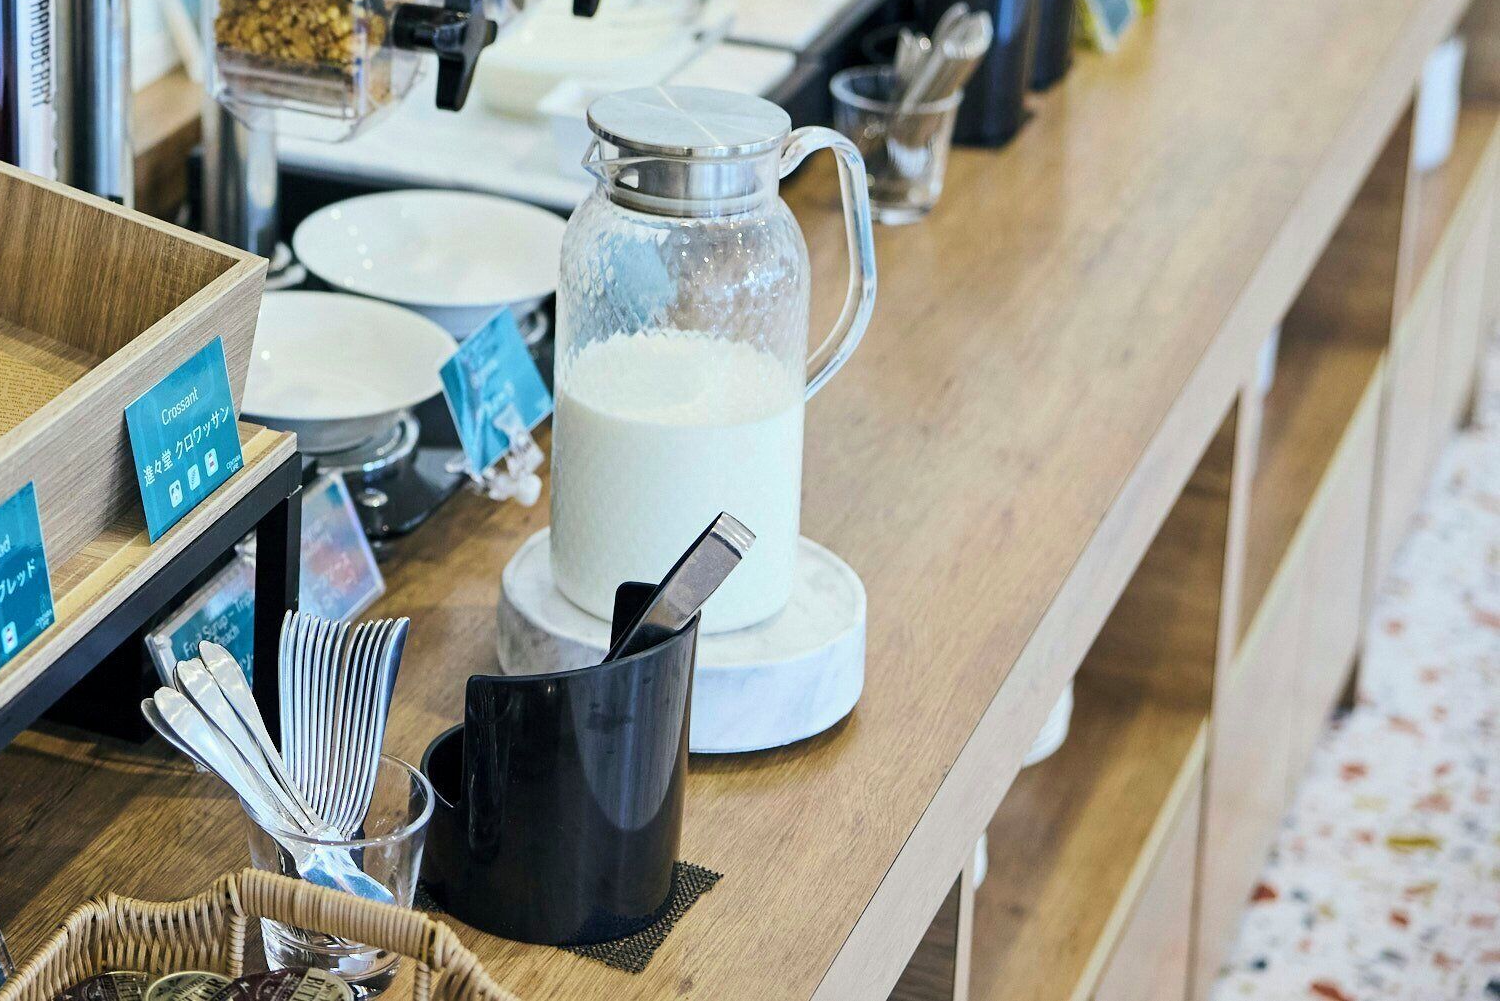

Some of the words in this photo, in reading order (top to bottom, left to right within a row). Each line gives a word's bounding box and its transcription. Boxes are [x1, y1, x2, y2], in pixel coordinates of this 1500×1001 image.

[161, 387, 199, 426] Crossant
[175, 406, 230, 460] クロワッサン
